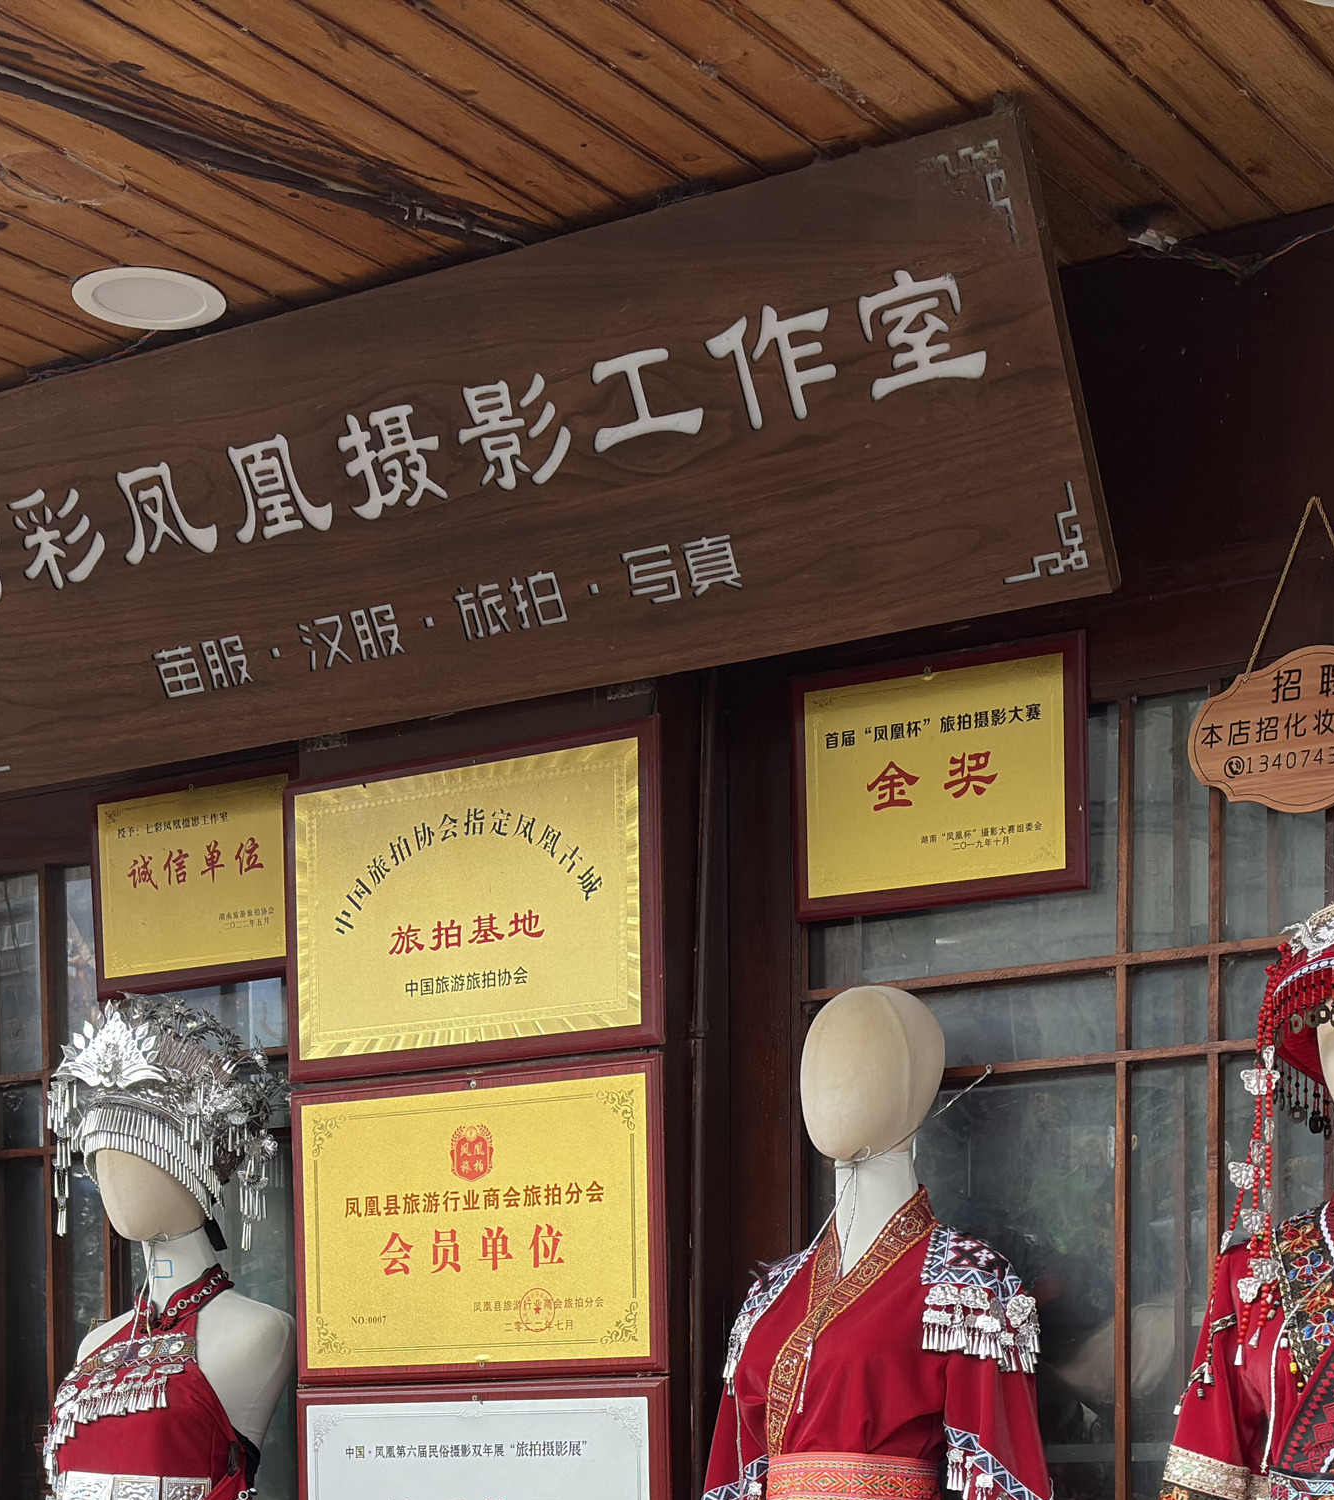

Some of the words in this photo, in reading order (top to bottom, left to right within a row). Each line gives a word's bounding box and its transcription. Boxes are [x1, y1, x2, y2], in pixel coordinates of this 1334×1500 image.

[866, 751, 998, 811] 金奖
[127, 837, 264, 890] 诚信单位
[335, 807, 605, 936] 中国旅拍协会指定凤凰古城
[388, 909, 545, 955] 旅拍基地
[404, 966, 528, 997] 中国旅游旅拍协会
[344, 1180, 605, 1219] 凤凰县旅游行业商会旅拍分会
[379, 1223, 565, 1276] 会员单位
[351, 1315, 387, 1325] NO:0007
[472, 1296, 605, 1313] 凤凰县旅游行业商会旅拍分会
